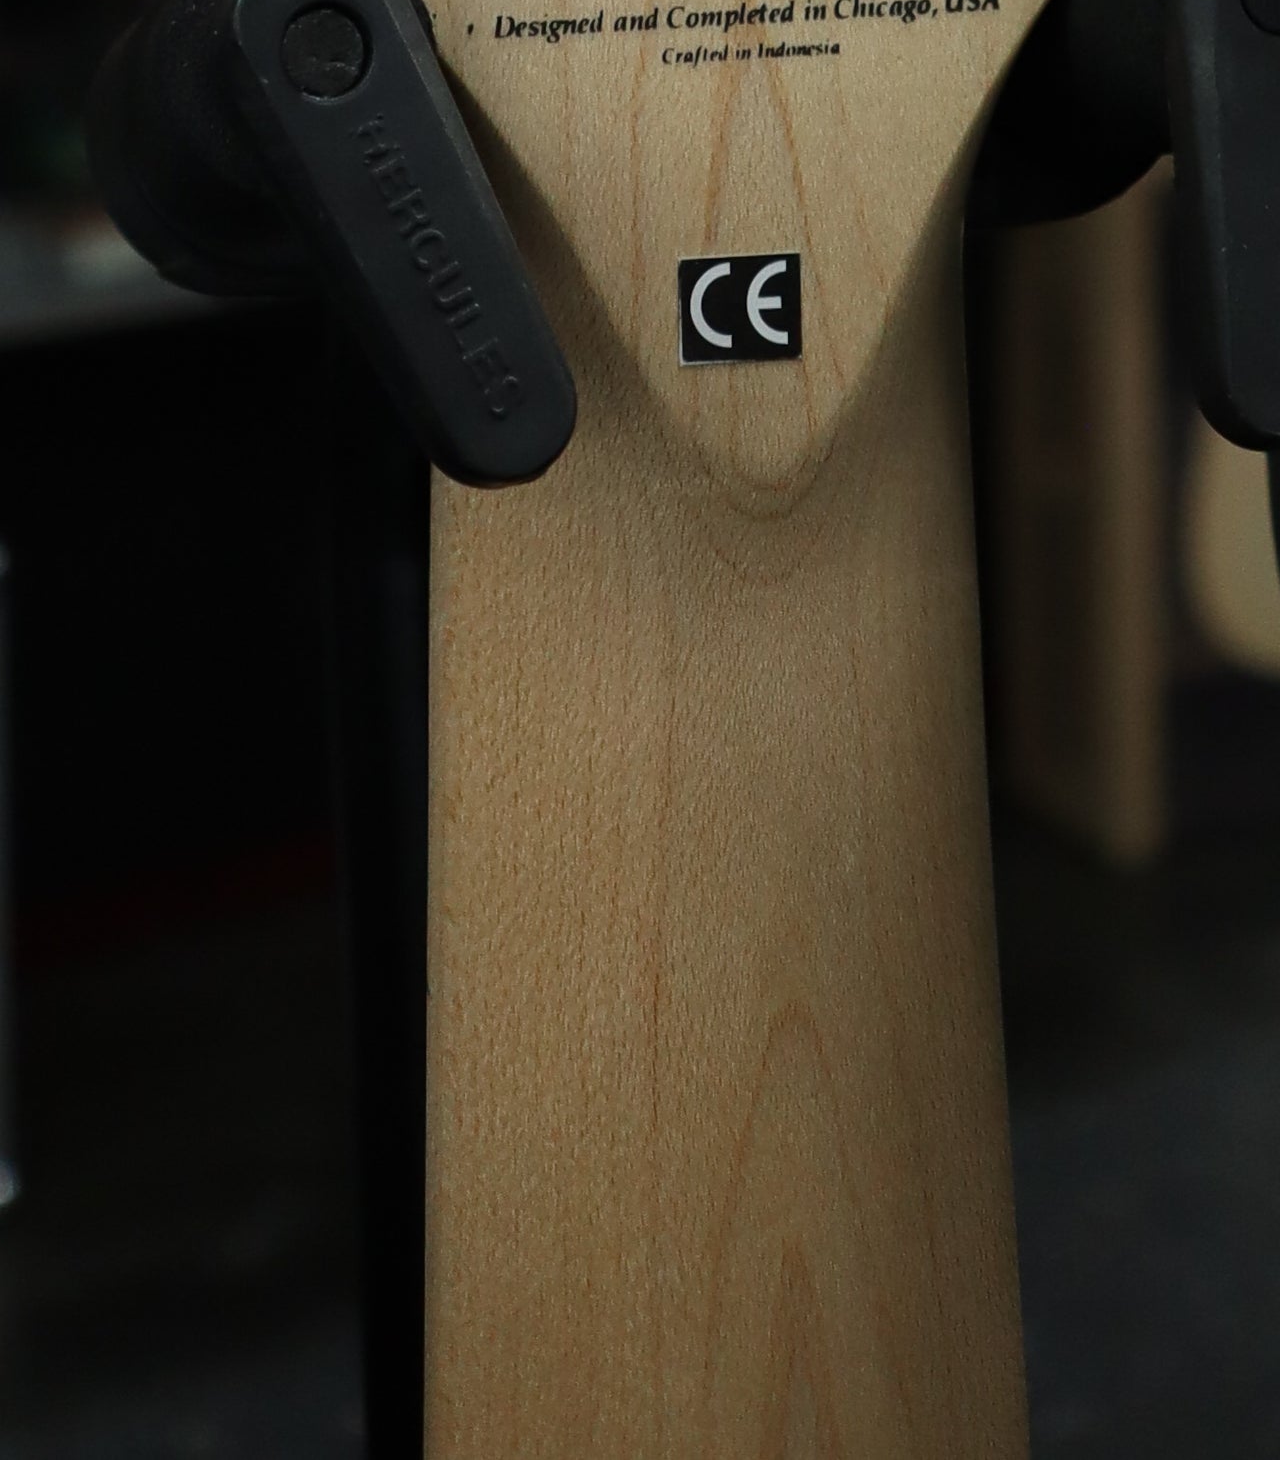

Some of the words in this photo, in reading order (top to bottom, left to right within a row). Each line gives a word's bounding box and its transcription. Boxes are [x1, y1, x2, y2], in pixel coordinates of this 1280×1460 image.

[494, 10, 604, 44] Designed
[613, 6, 660, 33] and
[666, 0, 794, 33] Completed
[661, 44, 729, 69] Crafted
[735, 45, 752, 61] in
[757, 40, 841, 60] Indonesia
[352, 113, 519, 419] HERCULES
[689, 259, 790, 350] CE
